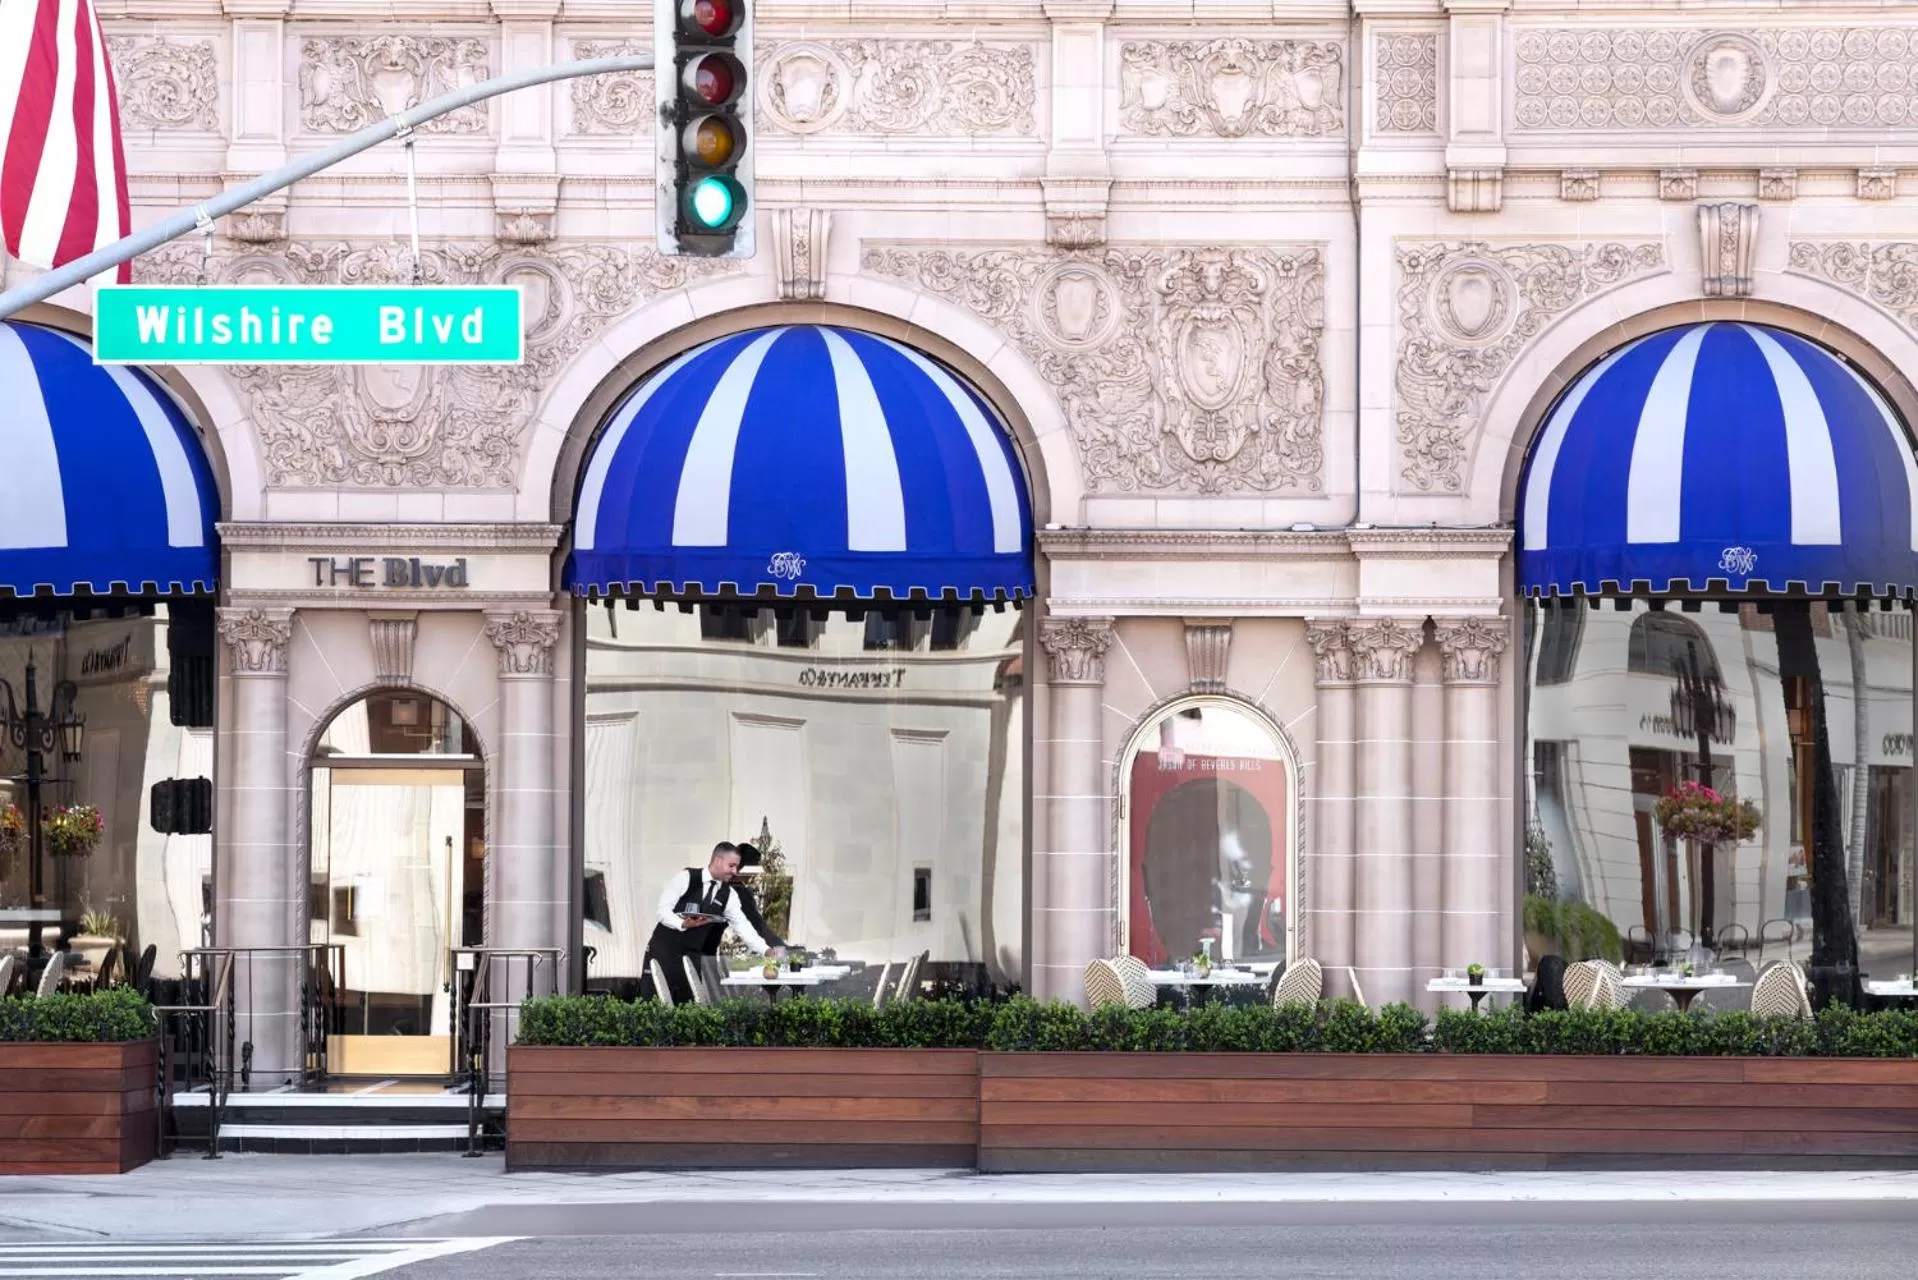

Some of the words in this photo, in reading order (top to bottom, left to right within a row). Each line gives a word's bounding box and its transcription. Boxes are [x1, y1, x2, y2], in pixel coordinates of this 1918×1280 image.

[136, 305, 334, 345] Wilshire
[379, 305, 484, 345] Blvd
[308, 557, 375, 586] THE
[382, 557, 469, 587] Blvd
